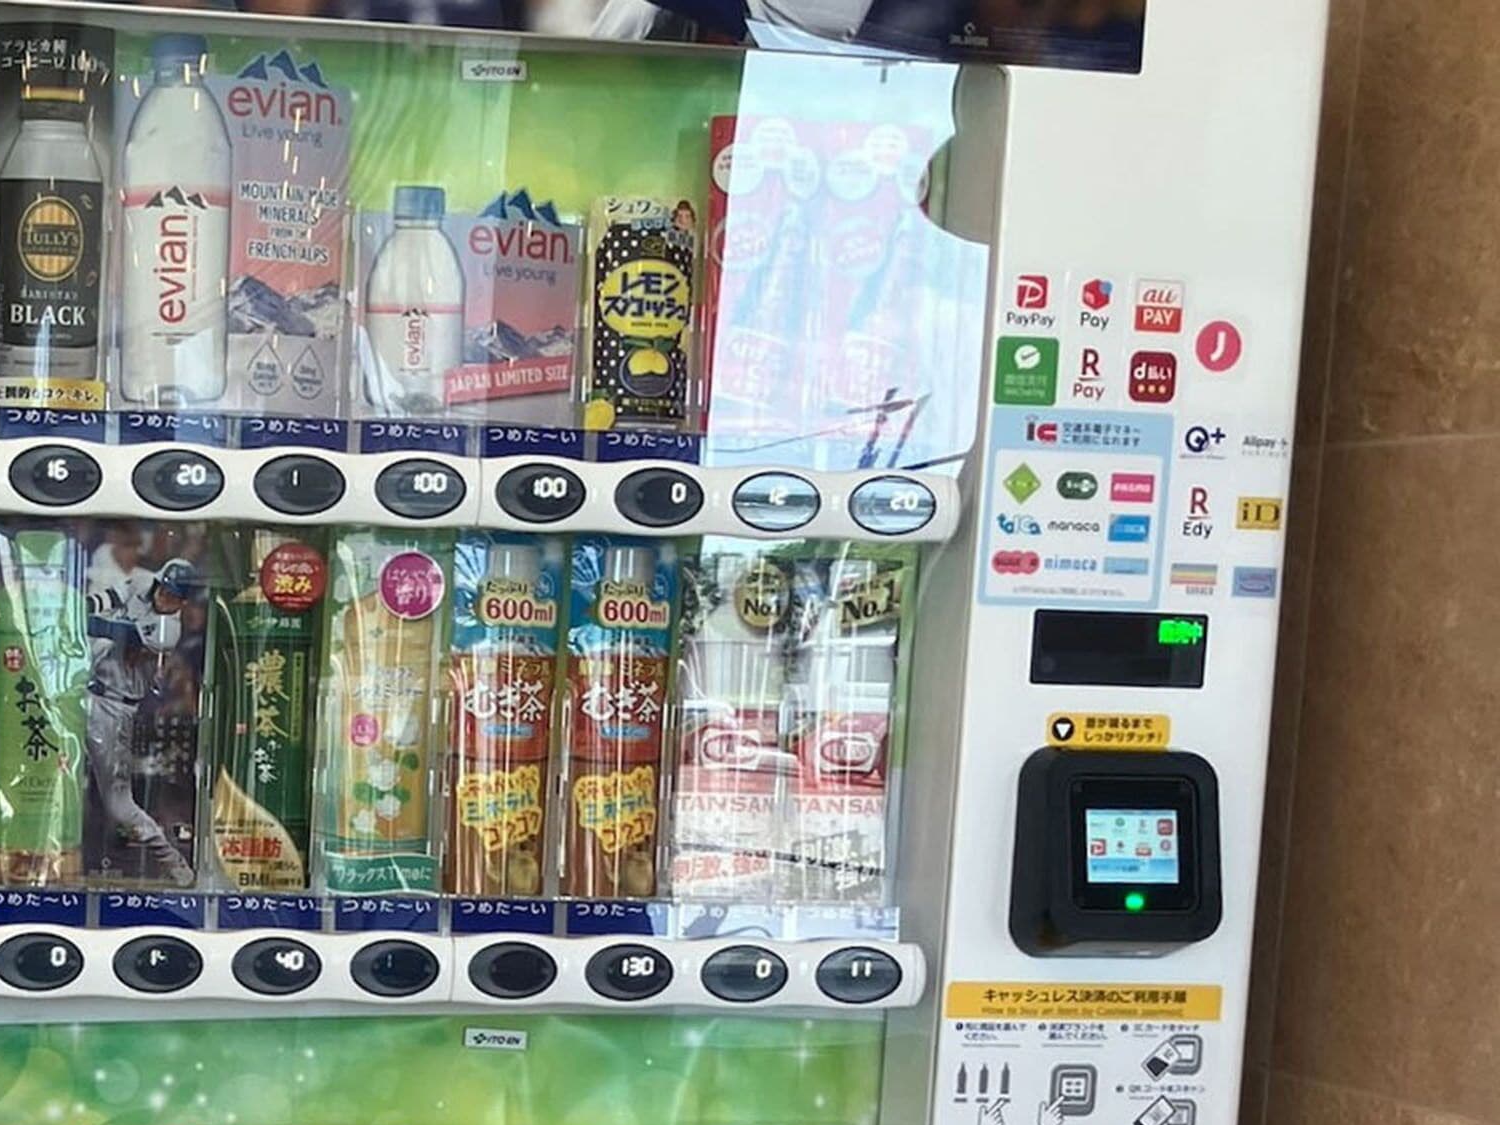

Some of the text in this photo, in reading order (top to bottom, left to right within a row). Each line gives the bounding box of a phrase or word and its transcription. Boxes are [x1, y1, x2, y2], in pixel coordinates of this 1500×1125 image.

[258, 205, 320, 224] MINERALS
[249, 241, 329, 264] FRENCH ALPS
[515, 265, 557, 287] young
[621, 271, 681, 295] レモン
[10, 304, 86, 326] BLACK
[1006, 311, 1055, 328] PayPay
[1080, 311, 1110, 331] Pay
[1142, 308, 1174, 325] PAY
[1080, 348, 1100, 376] R
[450, 364, 570, 390] JAPAN LIMITED SIZE
[1073, 382, 1105, 400] Pay
[176, 464, 206, 485] 20
[413, 472, 447, 493] 100
[532, 477, 567, 498] 100
[1189, 487, 1209, 514] R
[1241, 502, 1280, 522] iD
[1182, 522, 1213, 539] Edy
[1044, 554, 1097, 571] nimoca
[274, 575, 313, 593] 渋み
[486, 581, 529, 594] たっぷり
[603, 582, 645, 596] たっぷり
[485, 597, 554, 623] 600ml
[603, 599, 667, 623] 600ml
[743, 598, 781, 617] No.1
[841, 580, 895, 622] No.1
[463, 680, 545, 722] むぎ茶
[581, 680, 660, 722] むぎ茶
[221, 837, 283, 858] 体脂肪
[238, 873, 270, 887] BMI
[51, 947, 67, 966] 0
[621, 957, 653, 976] 130
[756, 961, 771, 979] 0
